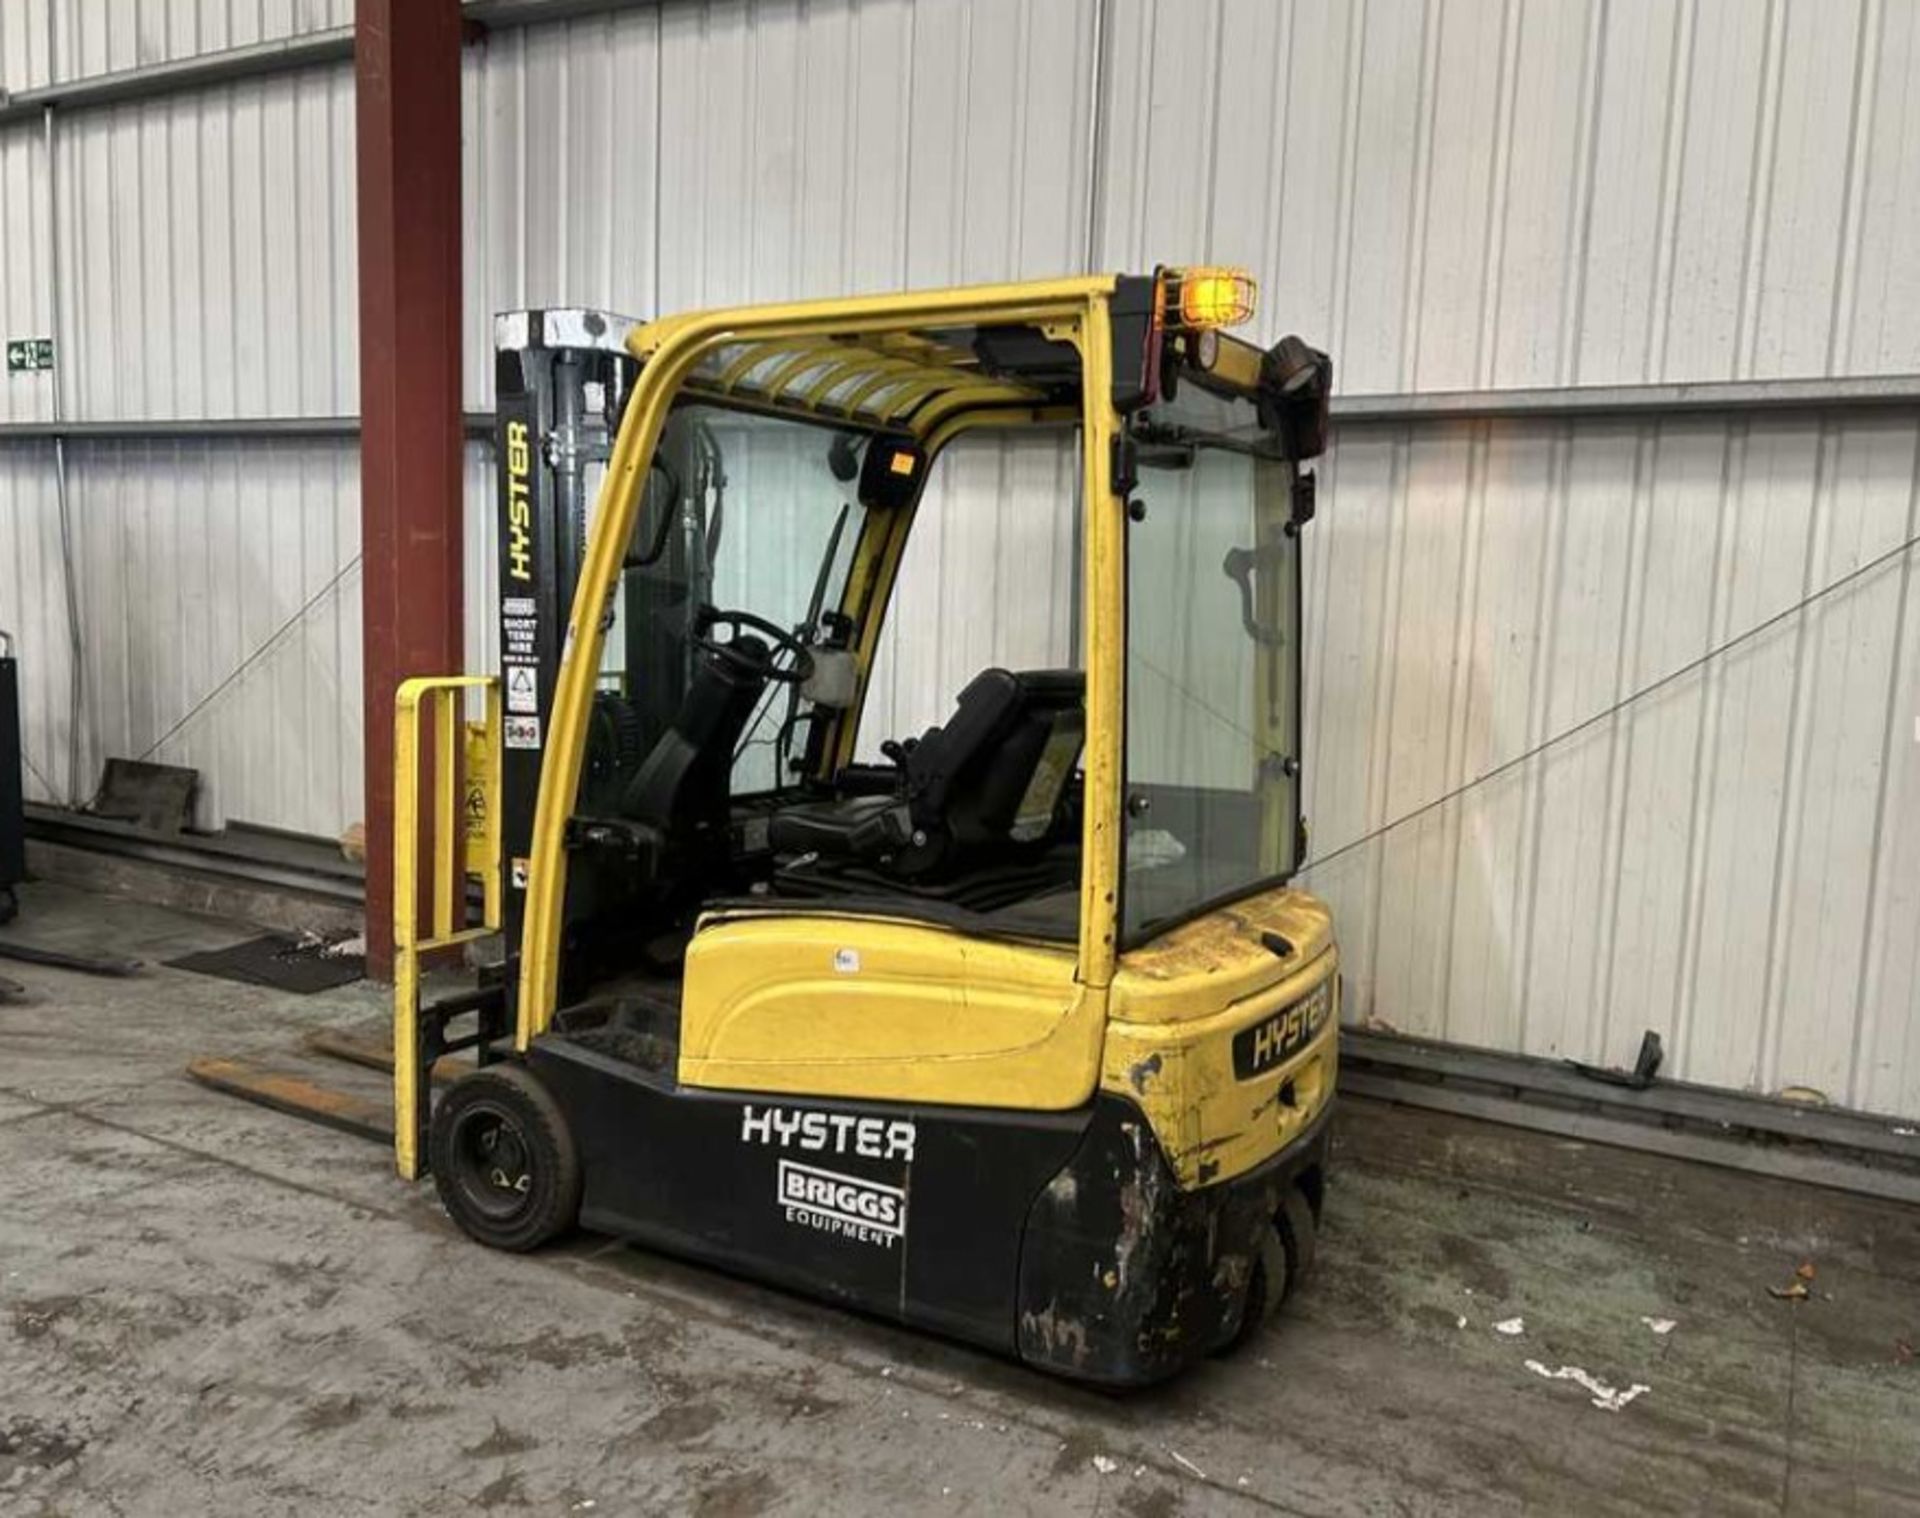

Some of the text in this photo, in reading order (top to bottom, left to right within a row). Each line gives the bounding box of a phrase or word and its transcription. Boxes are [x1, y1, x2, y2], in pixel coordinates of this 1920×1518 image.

[508, 421, 531, 580] HYSTER
[741, 1105, 916, 1161] HYSTER
[785, 1171, 897, 1222] BRIGGS
[785, 1206, 896, 1249] EQUIPMENT
